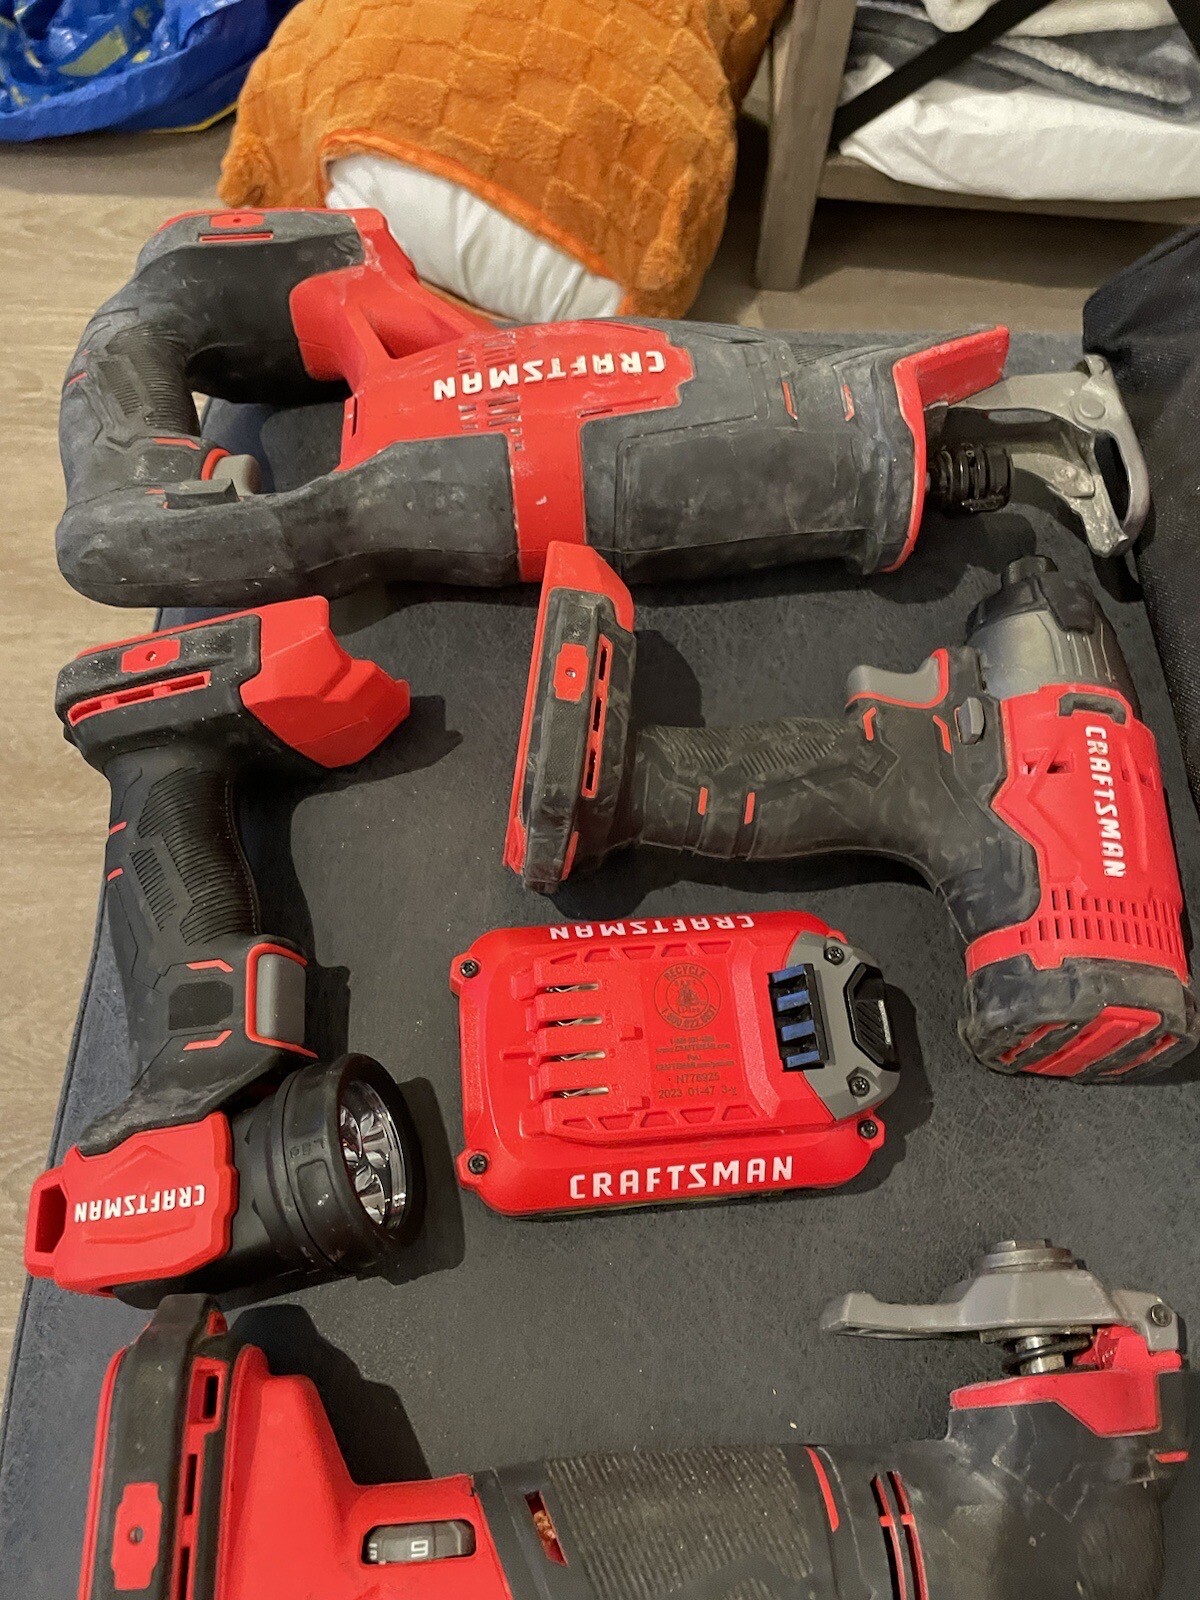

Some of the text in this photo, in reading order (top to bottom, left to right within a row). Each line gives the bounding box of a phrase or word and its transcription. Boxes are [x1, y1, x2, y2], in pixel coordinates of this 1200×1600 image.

[433, 350, 666, 401] CRAFTSMAN
[1085, 725, 1126, 878] CRAFTSMAN
[550, 915, 755, 940] CRAFTSMAN
[663, 965, 706, 981] RECYCLE
[658, 1088, 682, 1099] 2023
[569, 1155, 793, 1200] CRAFTSMAN
[74, 1184, 205, 1223] CRAFTSMAN
